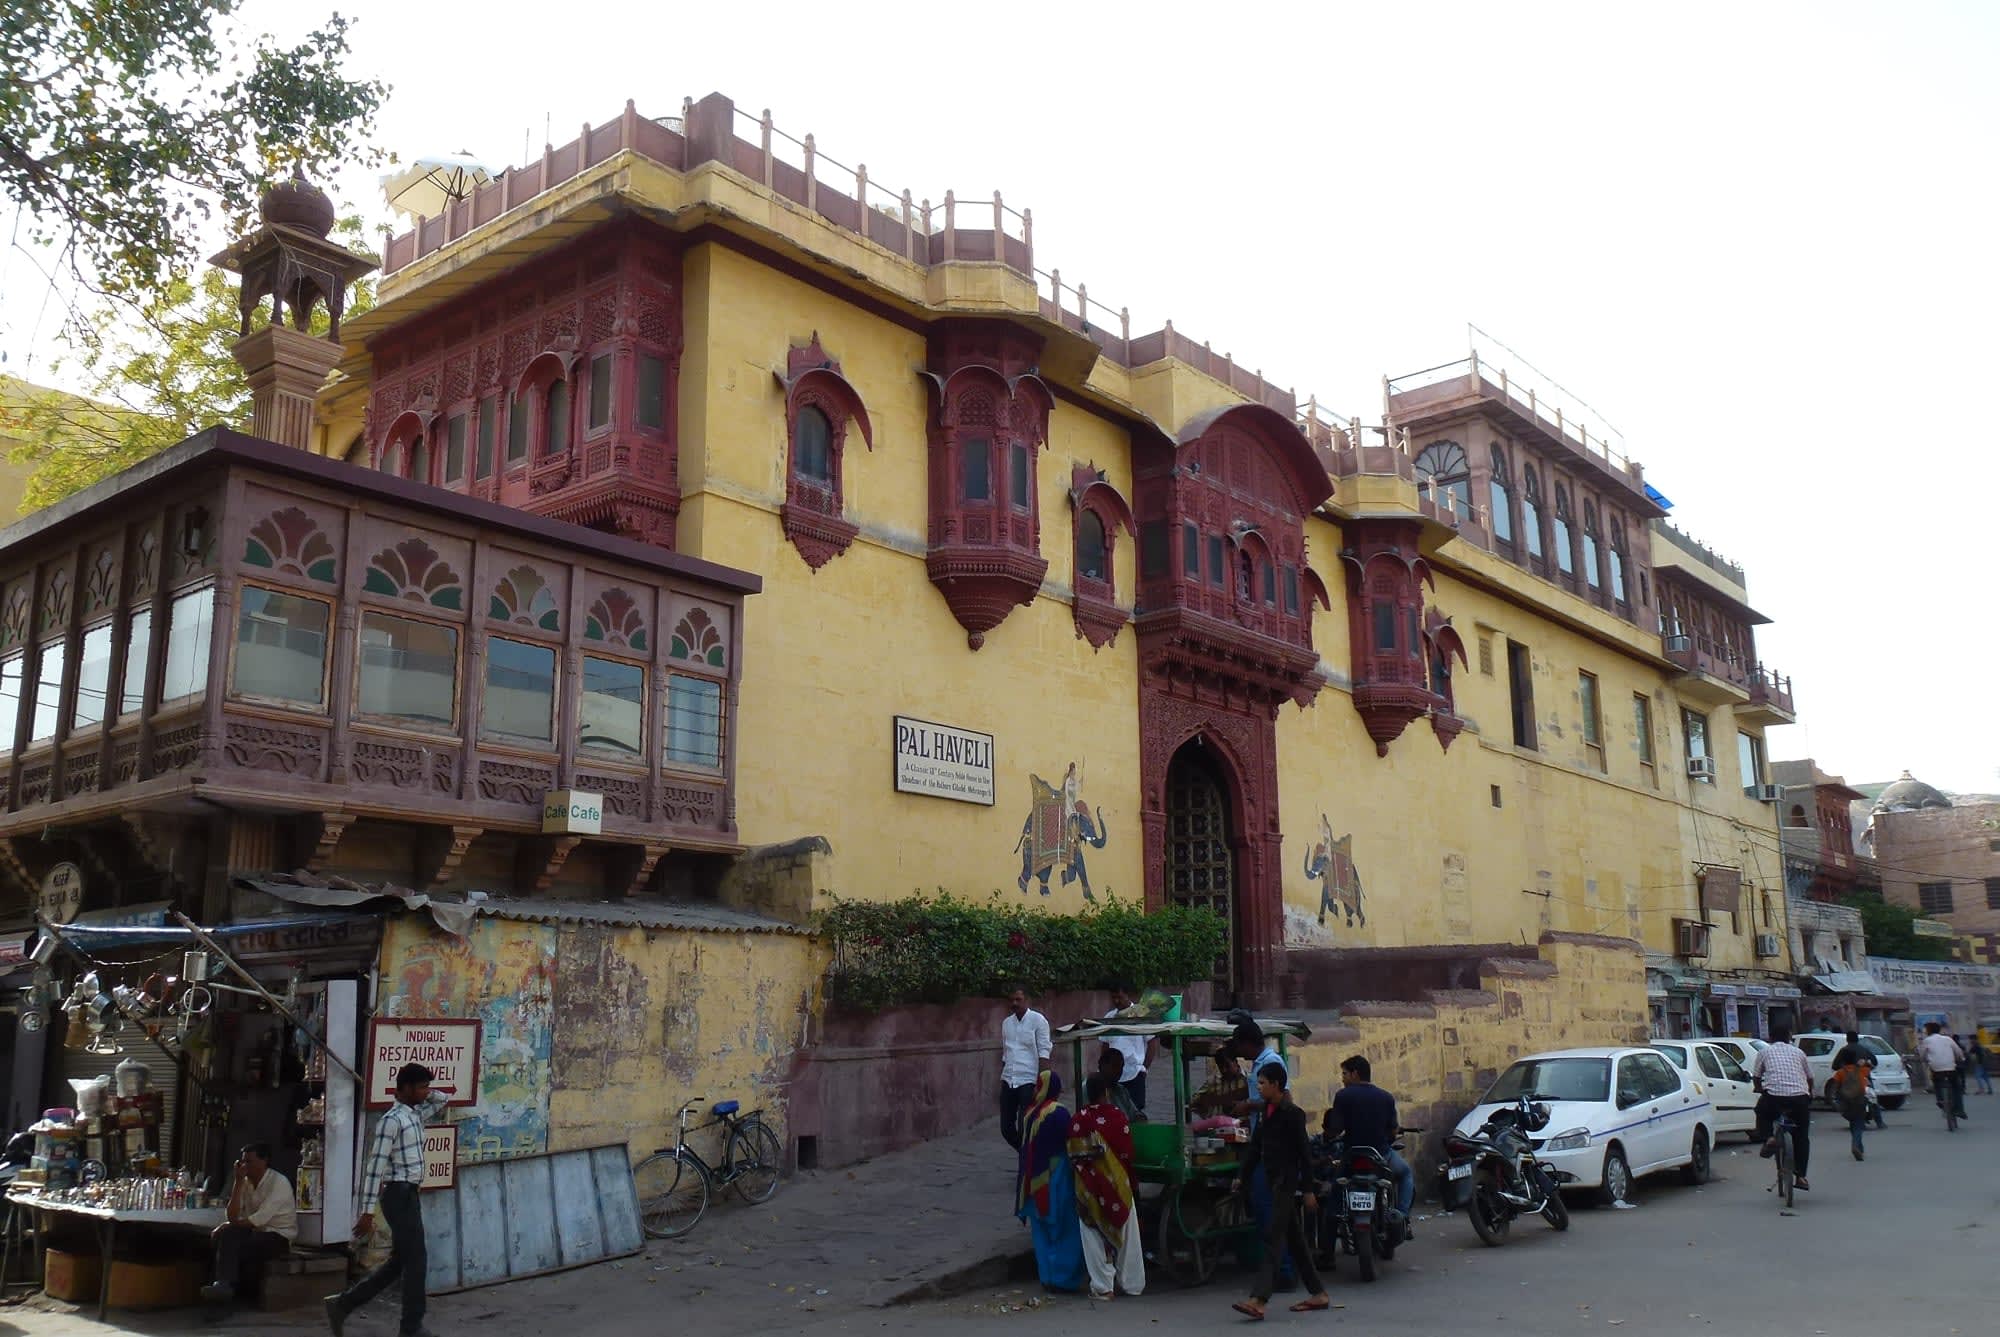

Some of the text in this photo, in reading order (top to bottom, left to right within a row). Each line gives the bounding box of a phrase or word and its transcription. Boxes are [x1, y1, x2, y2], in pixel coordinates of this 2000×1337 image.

[898, 725, 990, 769] PAL HAVELI
[905, 762, 910, 770] A
[405, 1031, 446, 1043] INDIQUE
[378, 1046, 464, 1062] RESTAURANT
[429, 1162, 450, 1177] SIDE
